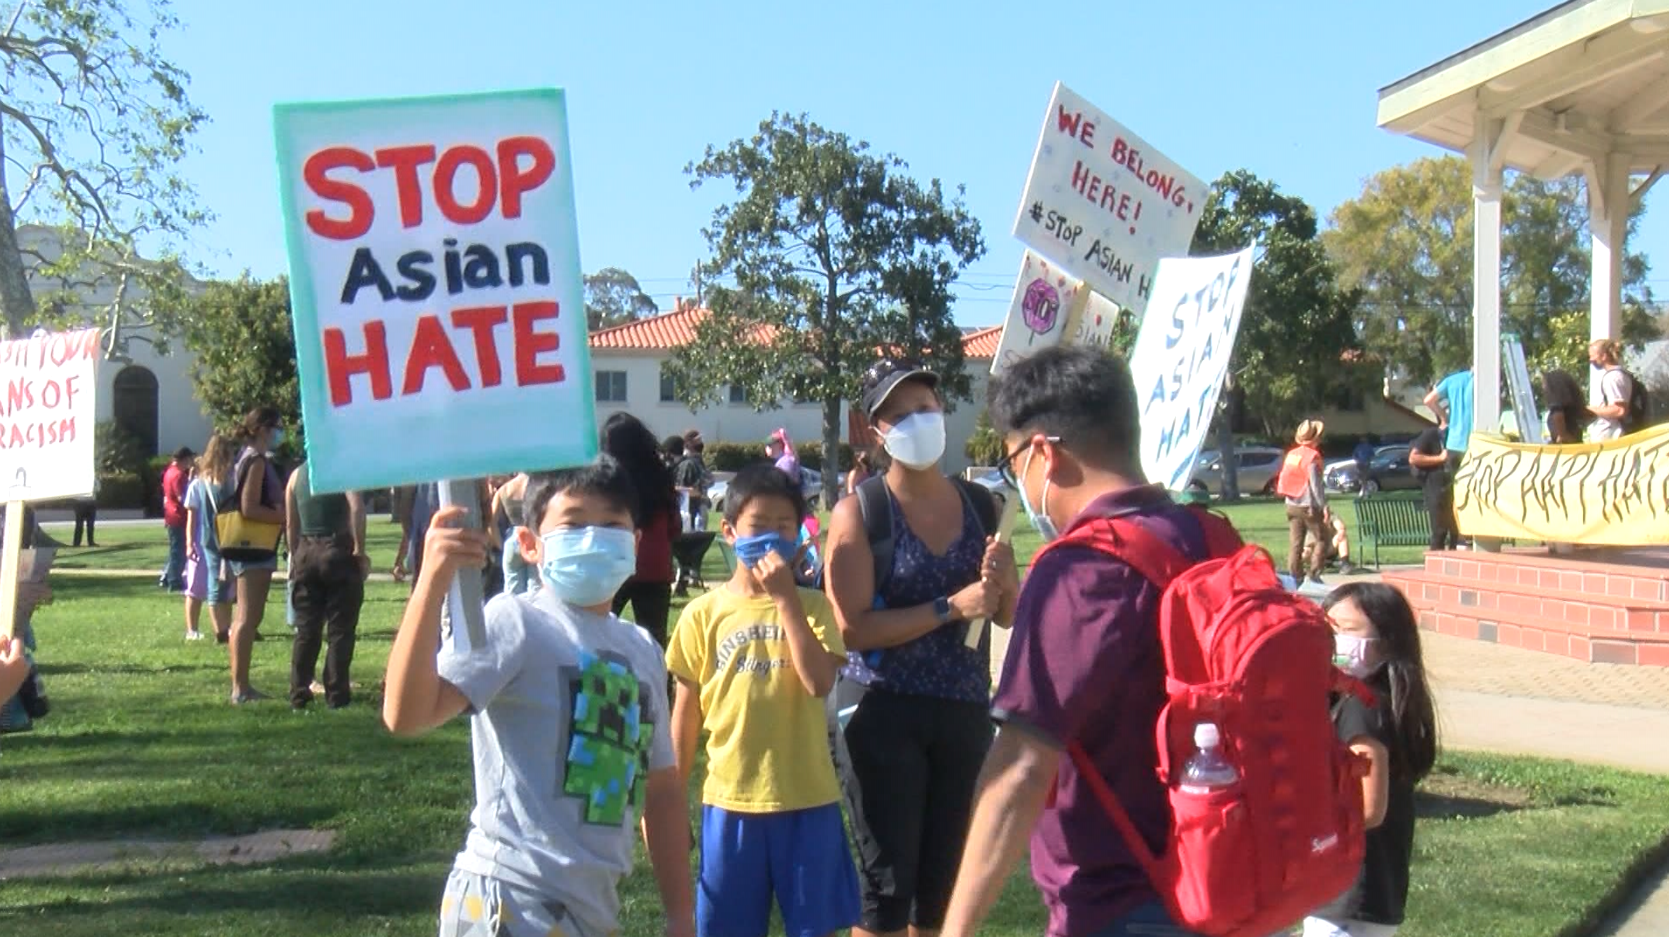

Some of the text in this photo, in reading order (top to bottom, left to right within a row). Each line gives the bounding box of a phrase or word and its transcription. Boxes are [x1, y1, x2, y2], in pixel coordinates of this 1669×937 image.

[1057, 103, 1096, 149] WE
[303, 135, 557, 242] STOP
[1071, 160, 1143, 236] HERE!
[339, 238, 551, 306] Asian
[1028, 200, 1135, 285] #STOP ASIAN
[1166, 256, 1241, 350] STOP
[322, 301, 566, 408] HATE
[1144, 302, 1235, 416] ASIAN
[0, 375, 80, 417] NS OF
[0, 416, 76, 449] RACISM
[1455, 447, 1522, 516] STOP
[1520, 444, 1604, 524] AAPI
